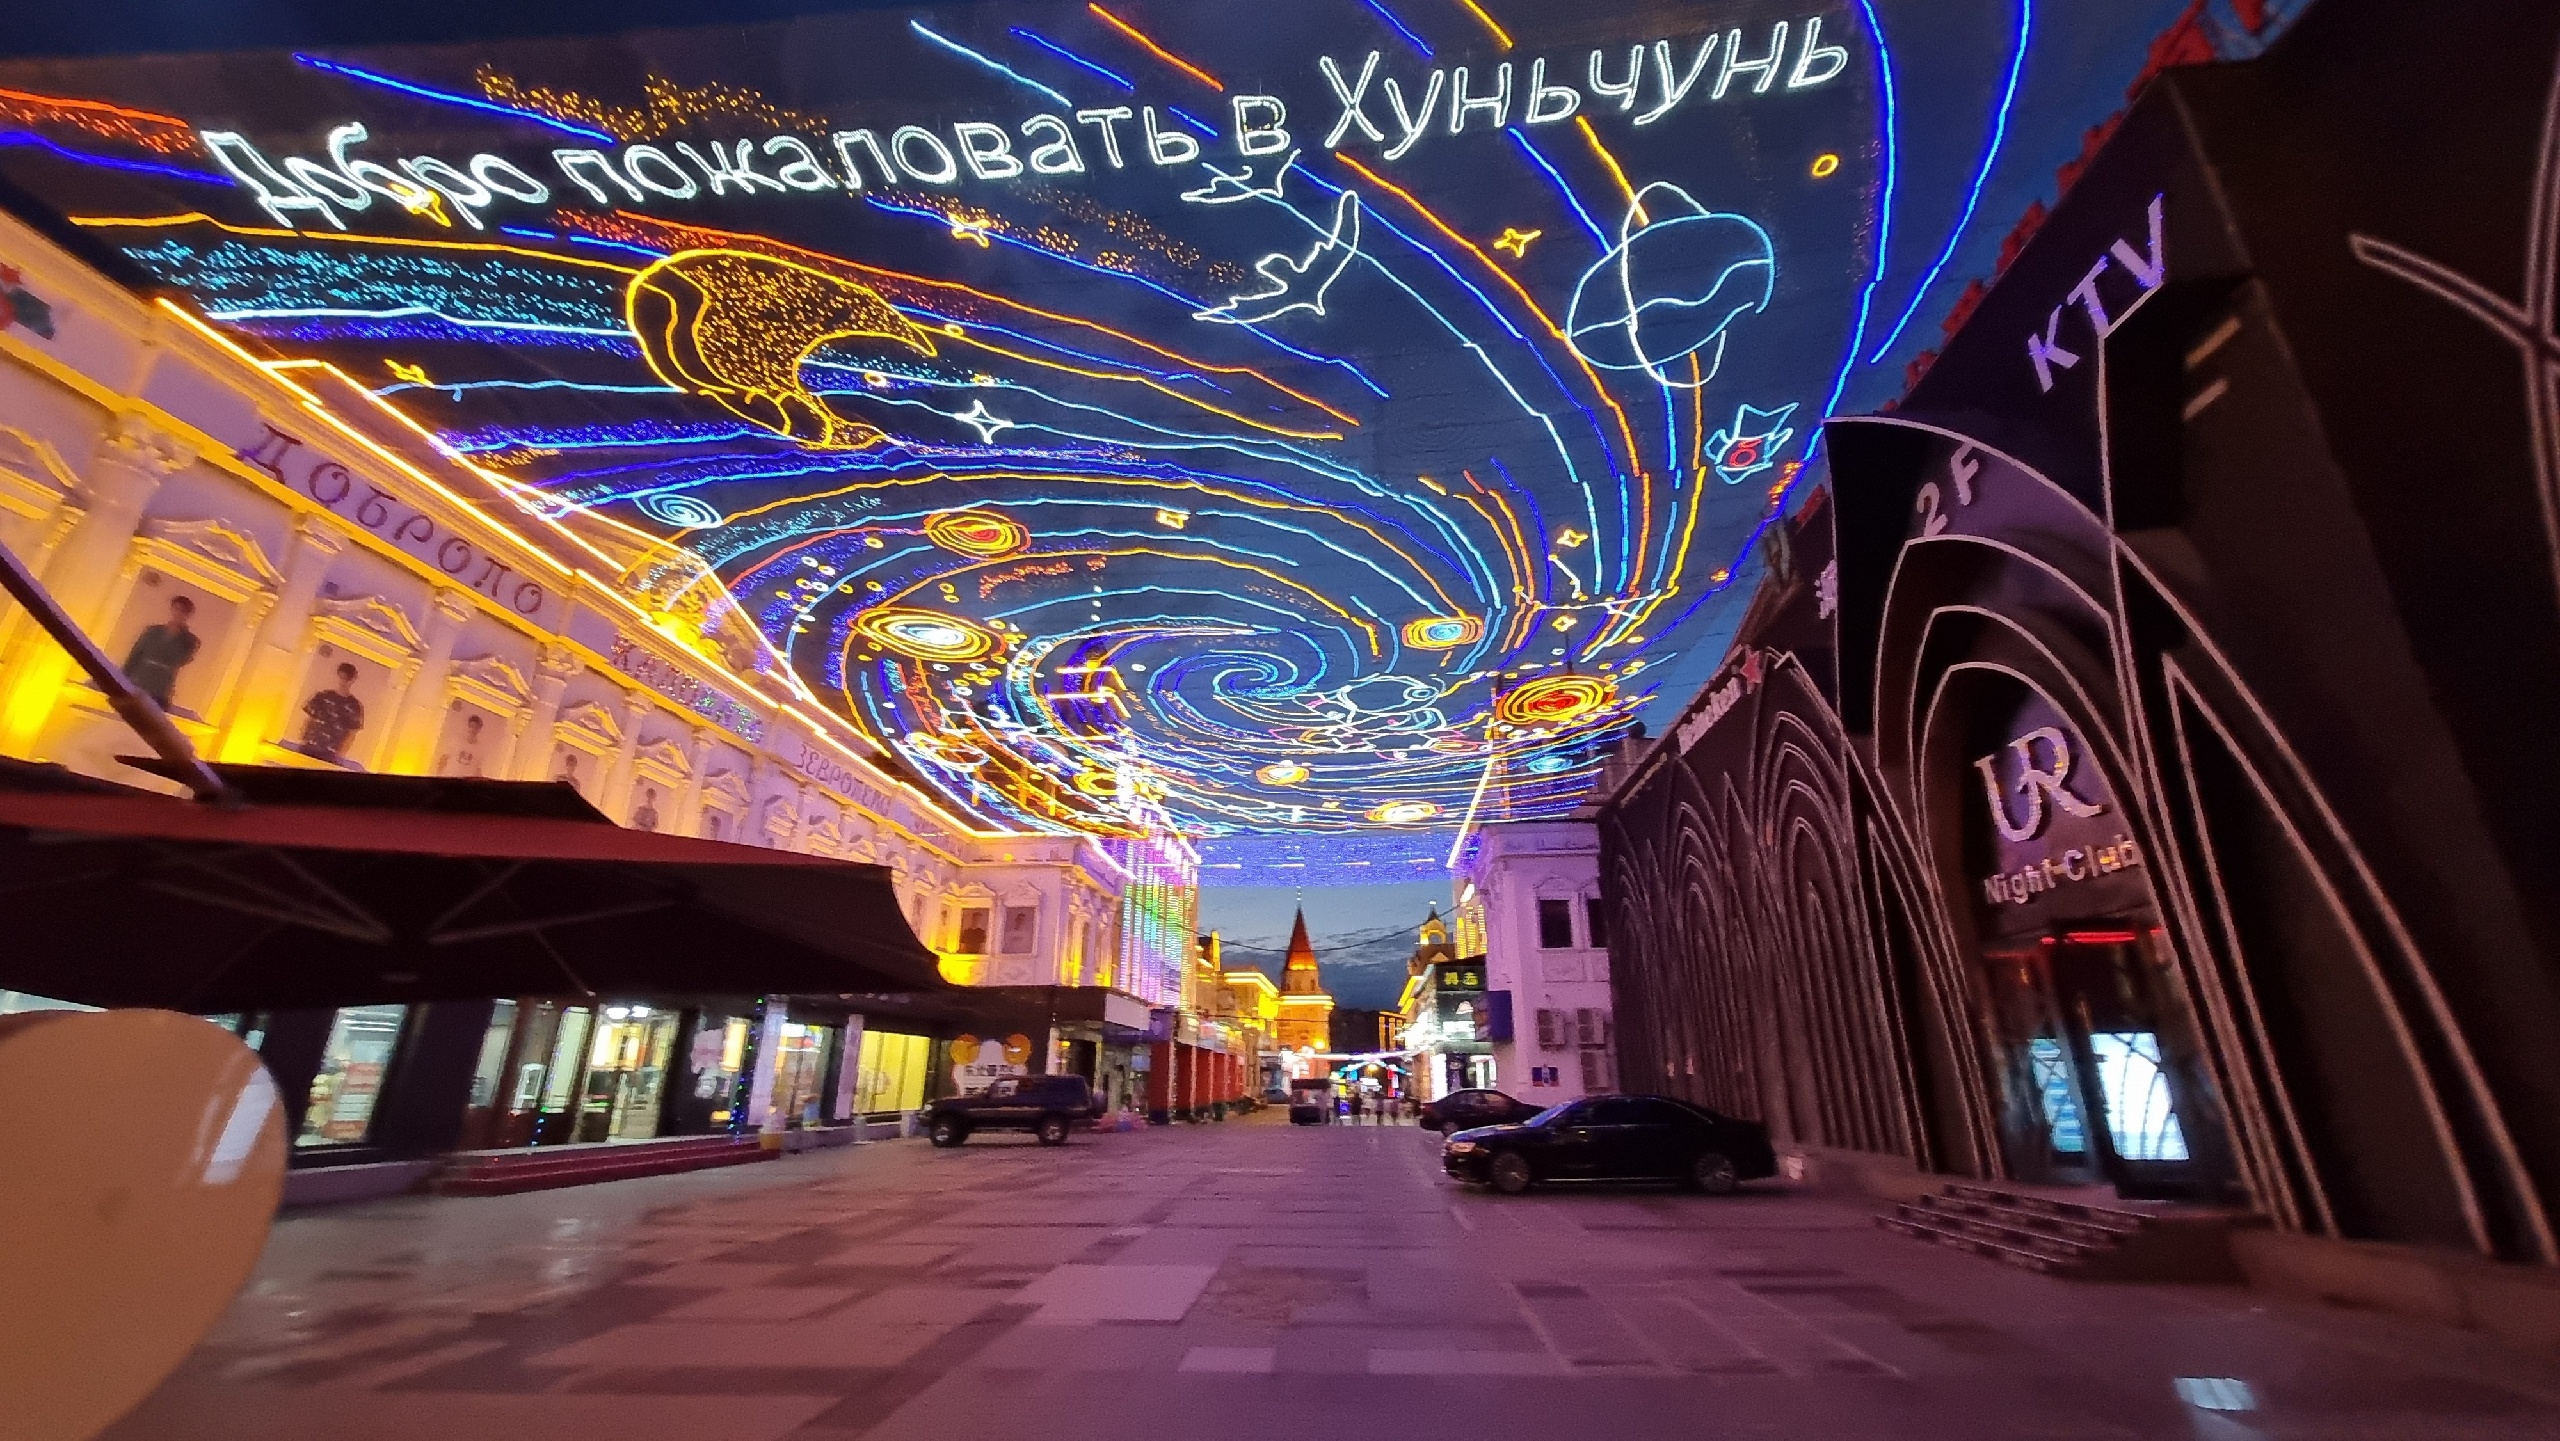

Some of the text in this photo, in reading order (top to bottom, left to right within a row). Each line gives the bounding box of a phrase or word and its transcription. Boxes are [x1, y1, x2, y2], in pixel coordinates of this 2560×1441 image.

[199, 121, 551, 231] Добро
[553, 104, 1201, 203] пожаловать
[1319, 17, 1850, 160] Хуньчунь
[2025, 192, 2166, 394] KTV
[1915, 440, 1986, 538] 2F
